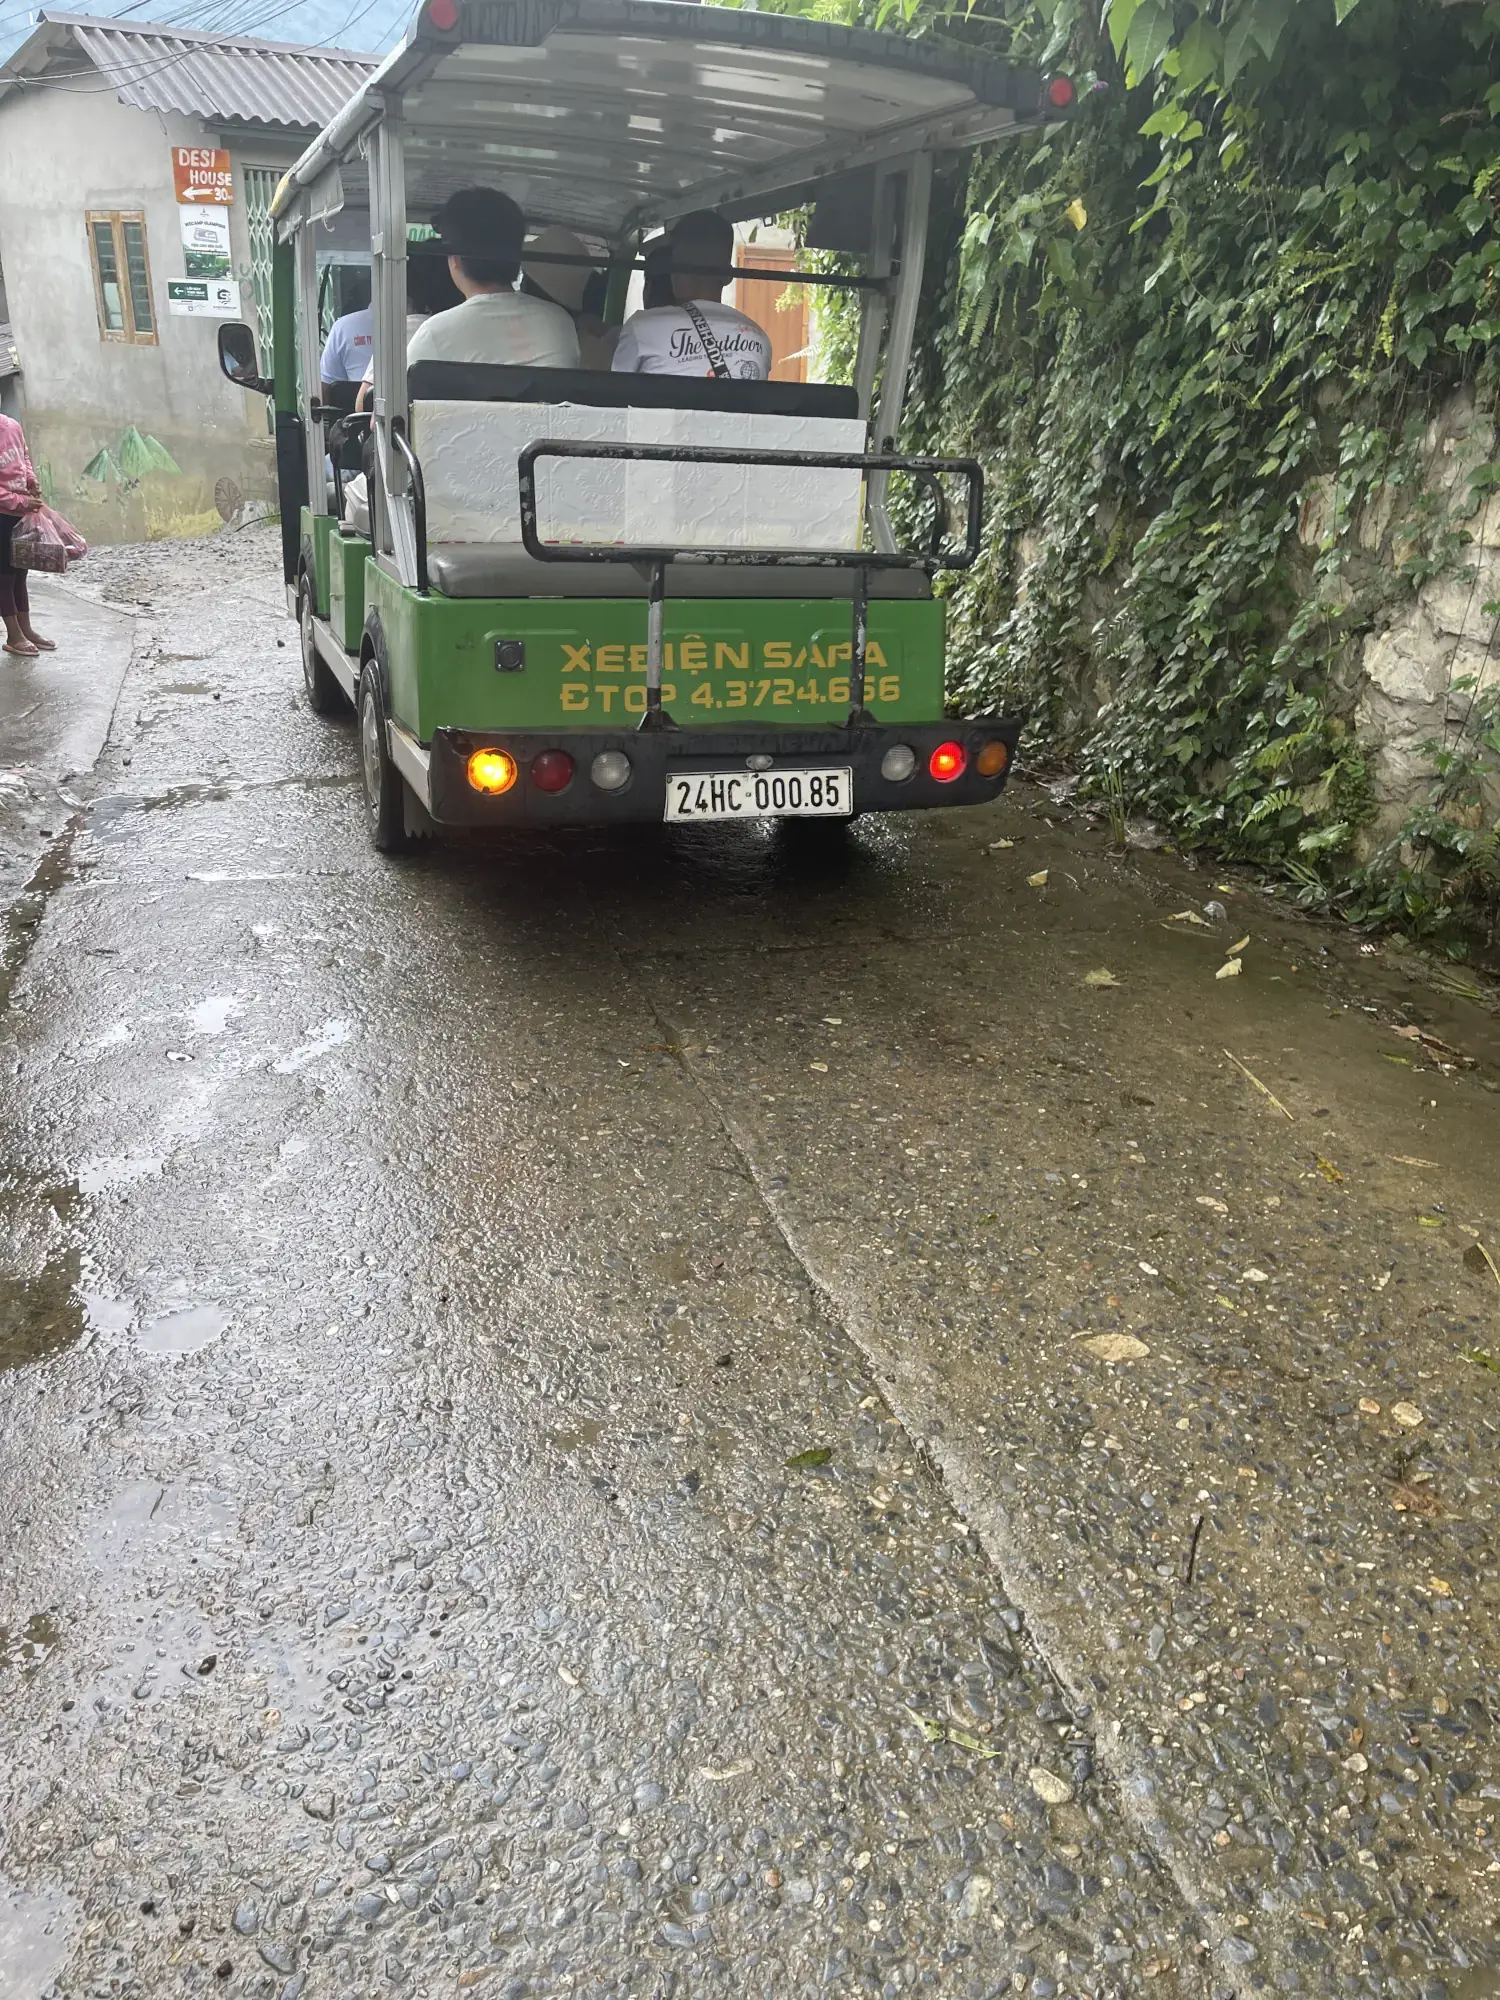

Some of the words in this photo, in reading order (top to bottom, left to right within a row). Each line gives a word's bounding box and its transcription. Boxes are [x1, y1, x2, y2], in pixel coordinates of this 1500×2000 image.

[190, 169, 232, 186] HOUSE
[669, 328, 703, 358] The
[716, 333, 763, 355] utdoors
[763, 641, 889, 668] SAPA
[677, 779, 742, 814] 24HC
[755, 775, 839, 810] 000.85
